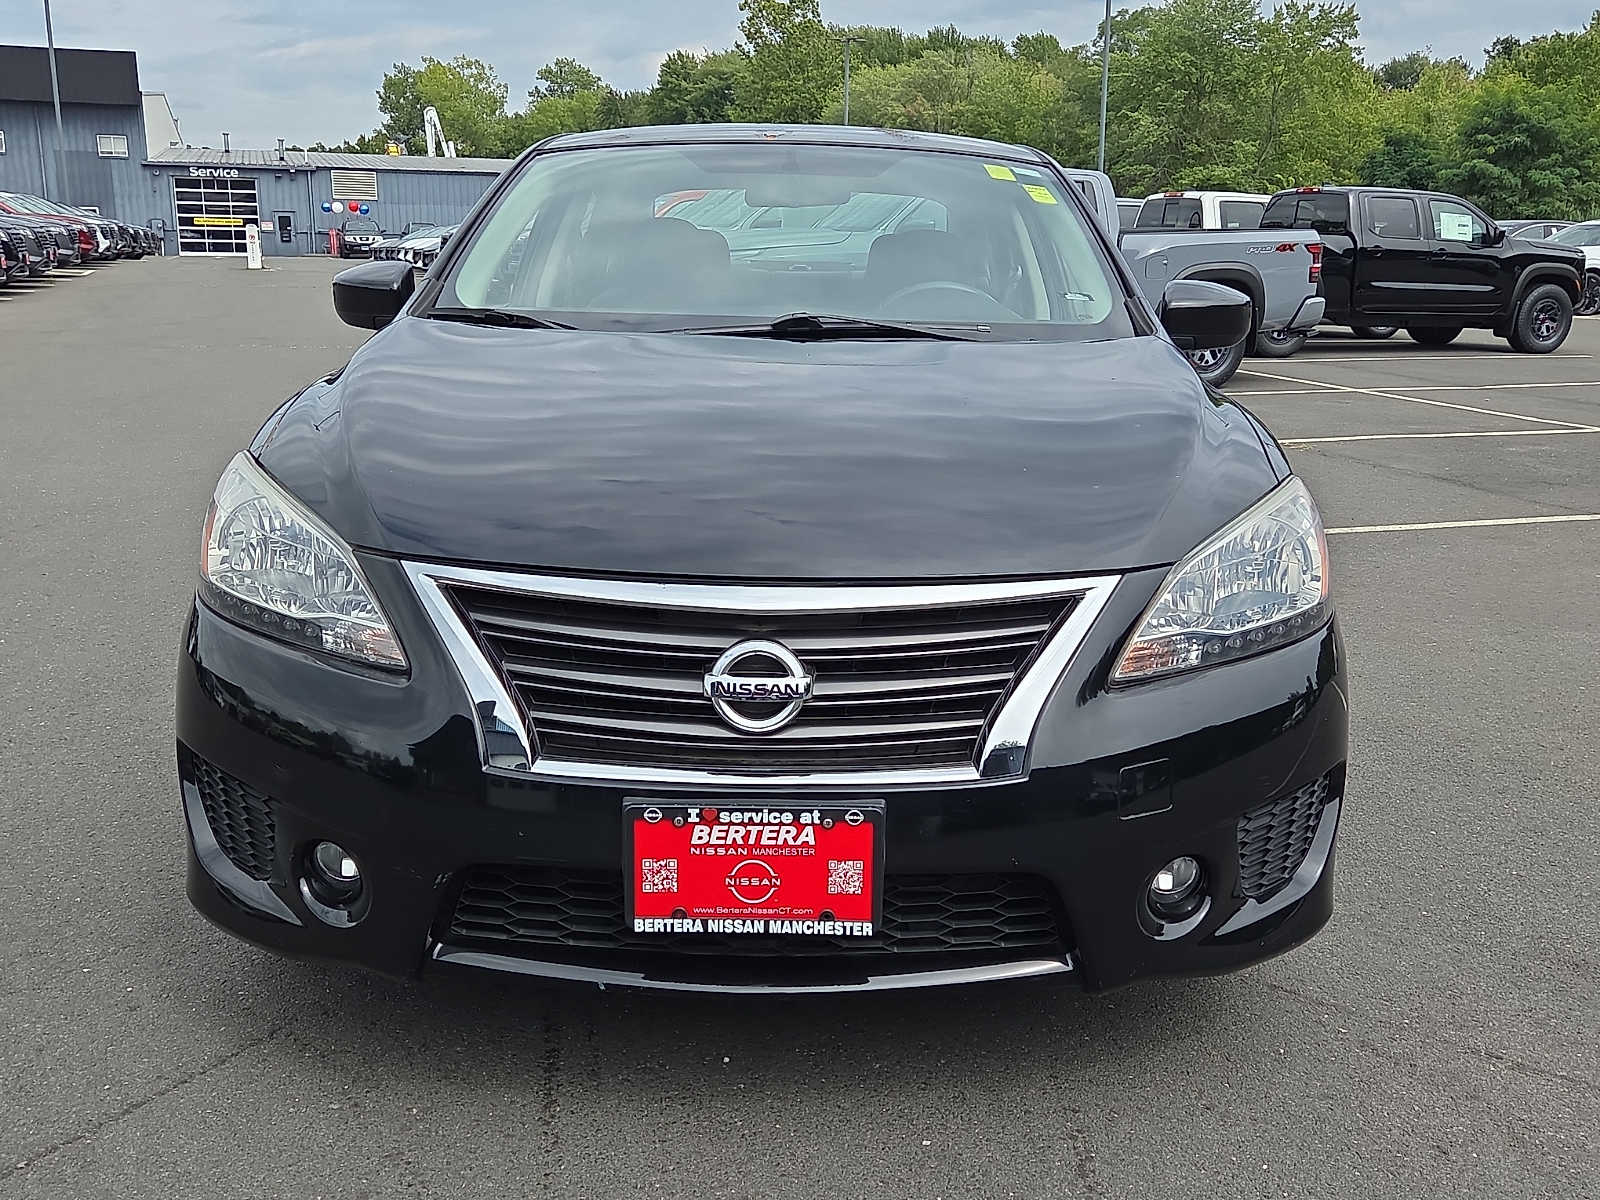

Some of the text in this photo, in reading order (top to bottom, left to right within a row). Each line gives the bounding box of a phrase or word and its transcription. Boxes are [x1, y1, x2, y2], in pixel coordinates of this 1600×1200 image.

[189, 166, 239, 178] Service
[710, 680, 800, 698] NISSAN
[687, 807, 821, 825] I service at
[690, 824, 816, 846] BERTERA
[690, 847, 816, 857] NISSAN MANCHESTER
[725, 877, 781, 887] NISSAN
[693, 906, 814, 915] www.BerteraNissanCT.com
[633, 918, 873, 937] BERTERA NISSAN MANCHESTER
